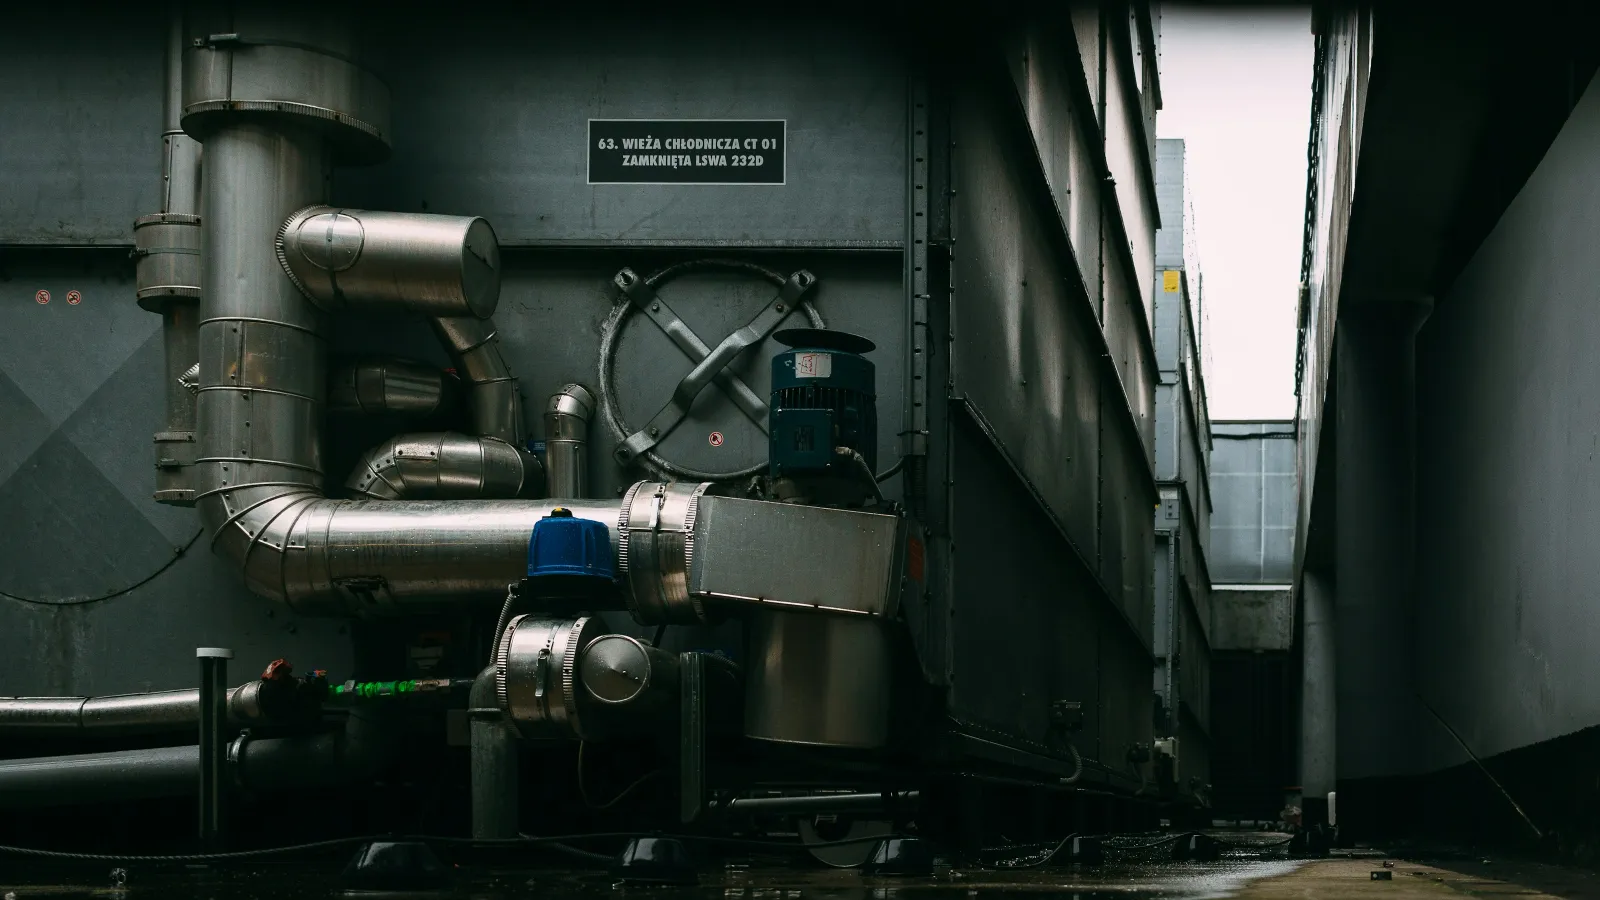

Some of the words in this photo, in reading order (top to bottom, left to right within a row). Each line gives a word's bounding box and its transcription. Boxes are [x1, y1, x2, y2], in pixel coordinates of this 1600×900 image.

[598, 138, 619, 150] 63.
[622, 135, 661, 150] WIEŻA
[665, 138, 740, 150] CHŁODNICZA
[743, 138, 758, 150] CT
[761, 138, 777, 150] 01
[622, 155, 692, 168] ZAMKNIĘTA
[695, 155, 728, 167] LSWA
[731, 155, 764, 167] 232D
